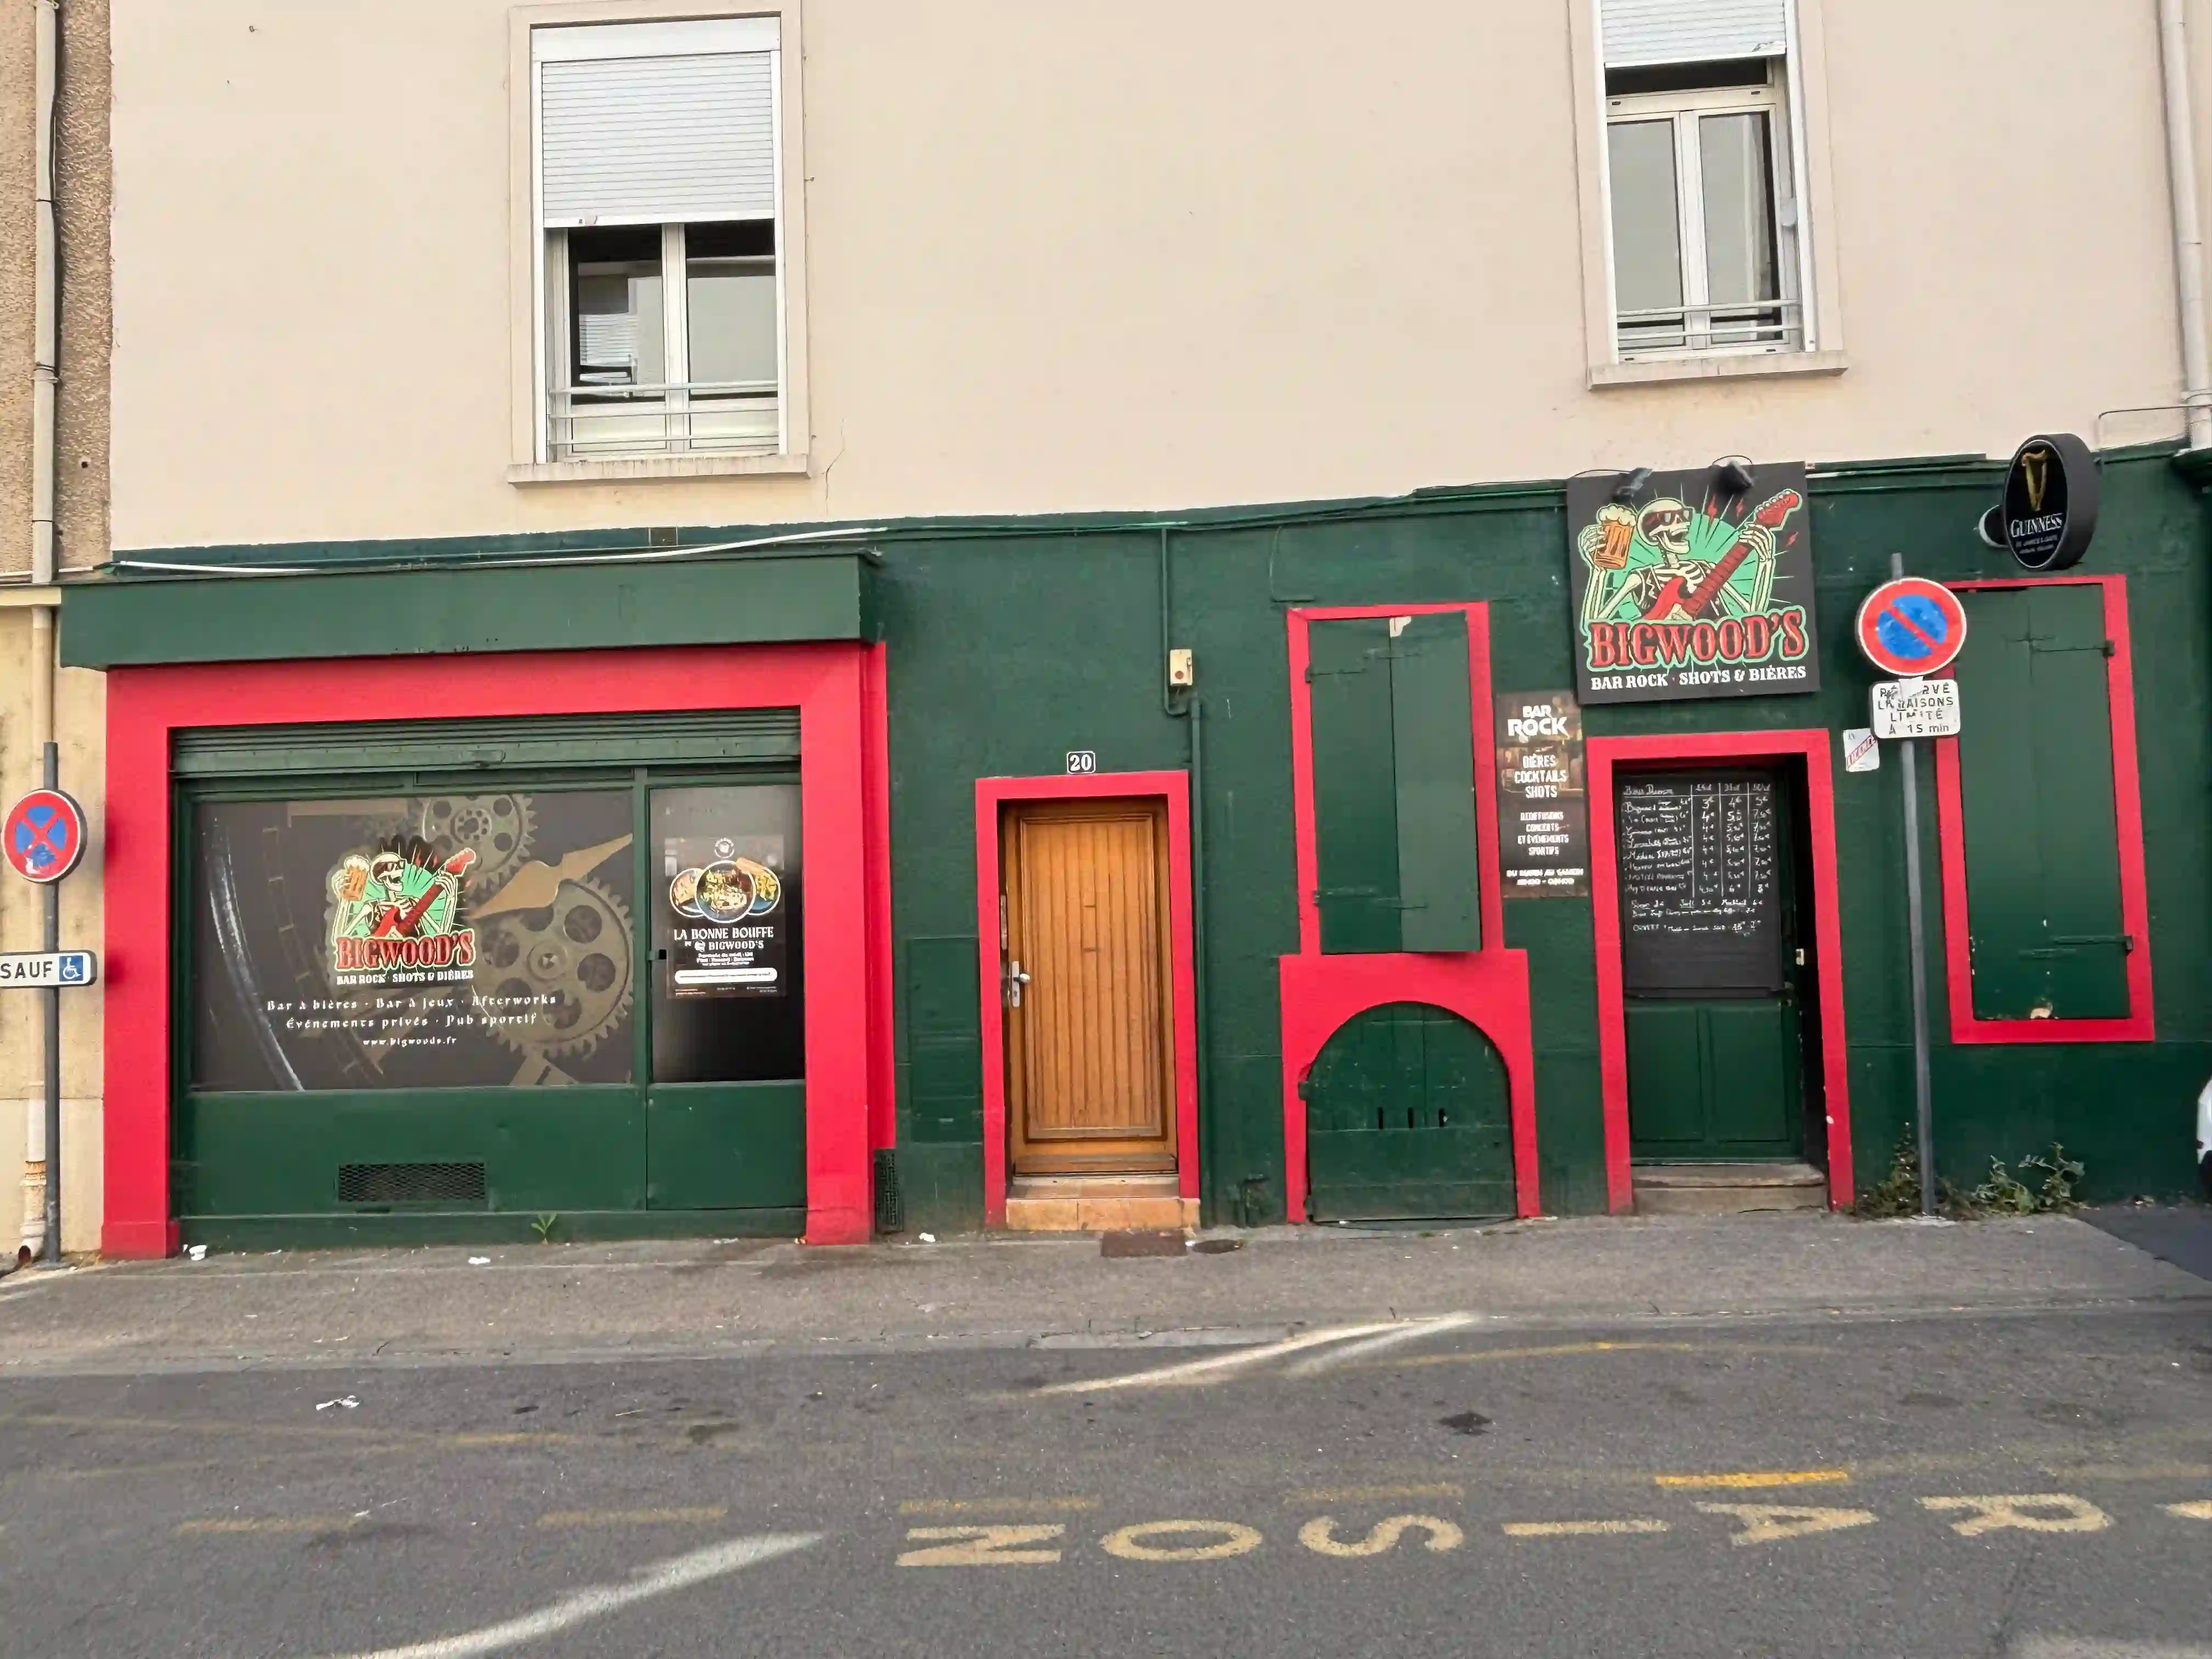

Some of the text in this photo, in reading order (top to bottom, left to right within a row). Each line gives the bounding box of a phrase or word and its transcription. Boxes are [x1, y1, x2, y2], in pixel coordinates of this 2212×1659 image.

[2011, 512, 2063, 538] GUINNESS
[1591, 610, 1803, 668] BIGWOOD'S
[1591, 677, 1622, 690] BAR
[1627, 673, 1668, 689] ROCK
[1679, 669, 1731, 685] SHOTS
[1734, 669, 1745, 682] &
[1523, 705, 1553, 719] BAR
[1508, 716, 1570, 743] ROCK
[1908, 724, 1923, 734] 15
[1929, 724, 1949, 733] min
[1070, 754, 1092, 771] 20
[1514, 770, 1568, 783] COCKTAILS
[1525, 785, 1558, 799] SHOTS
[674, 926, 775, 941] LA BONNE BOUFFE
[336, 932, 475, 969] BIGWOOD'S
[1, 961, 53, 979] SAUF
[337, 974, 357, 985] BAR
[359, 973, 386, 984] ROCK
[392, 972, 426, 983] SHOTS
[267, 1000, 292, 1010] Bar
[376, 997, 402, 1009] Bar
[423, 997, 454, 1009] jeux
[472, 994, 556, 1006] Afterworks
[445, 1014, 474, 1028] Pub
[482, 1012, 537, 1028] sportif
